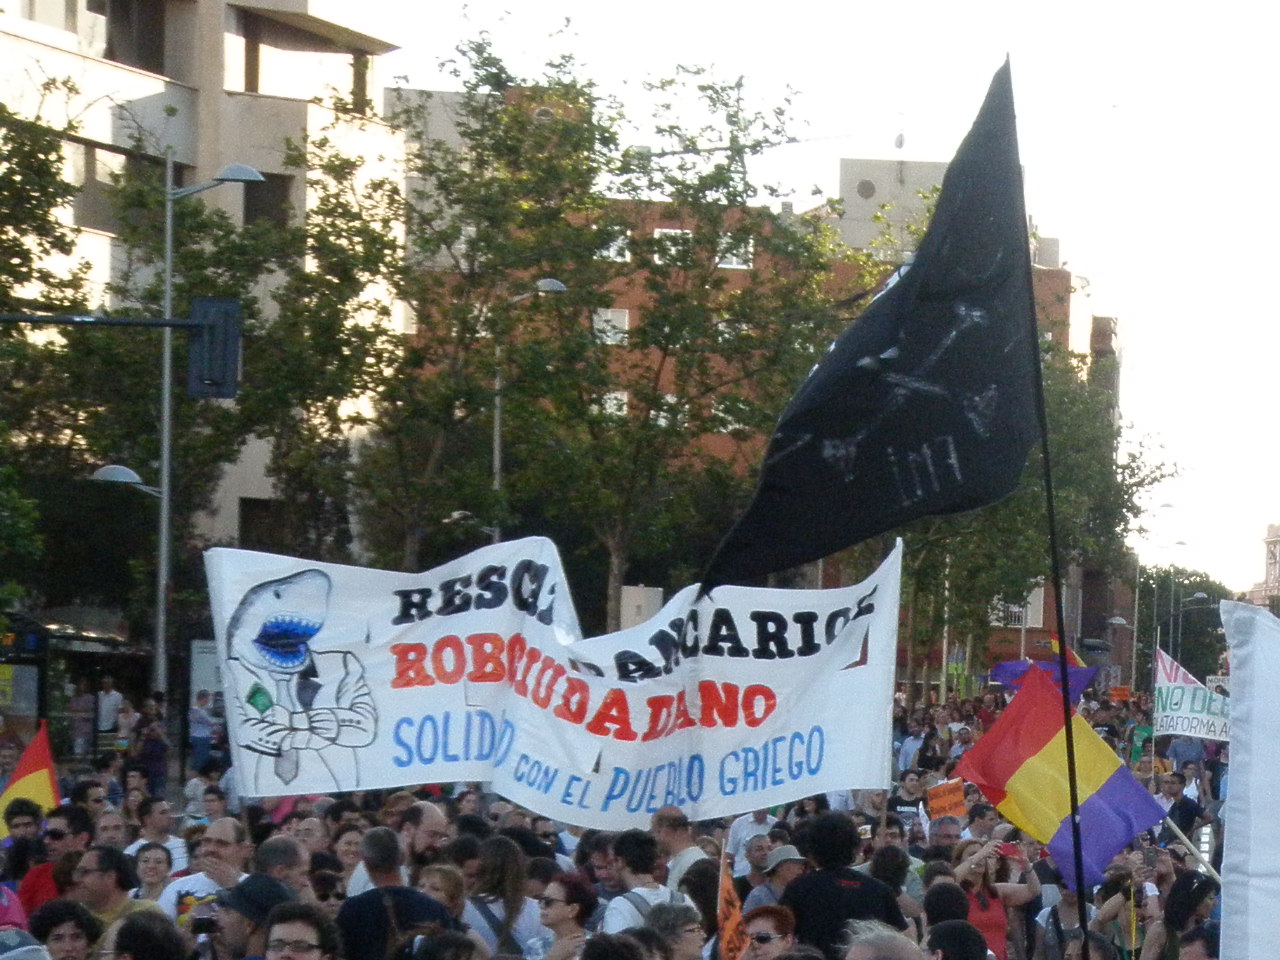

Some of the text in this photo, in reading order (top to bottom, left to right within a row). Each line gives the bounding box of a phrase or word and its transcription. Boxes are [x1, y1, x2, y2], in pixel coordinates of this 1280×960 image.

[505, 631, 777, 742] CIUDADANO
[1157, 686, 1185, 713] NO
[513, 753, 559, 794] CON
[563, 774, 591, 809] EL
[600, 752, 704, 814] PUEBLO
[718, 724, 825, 797] GRIEGO
